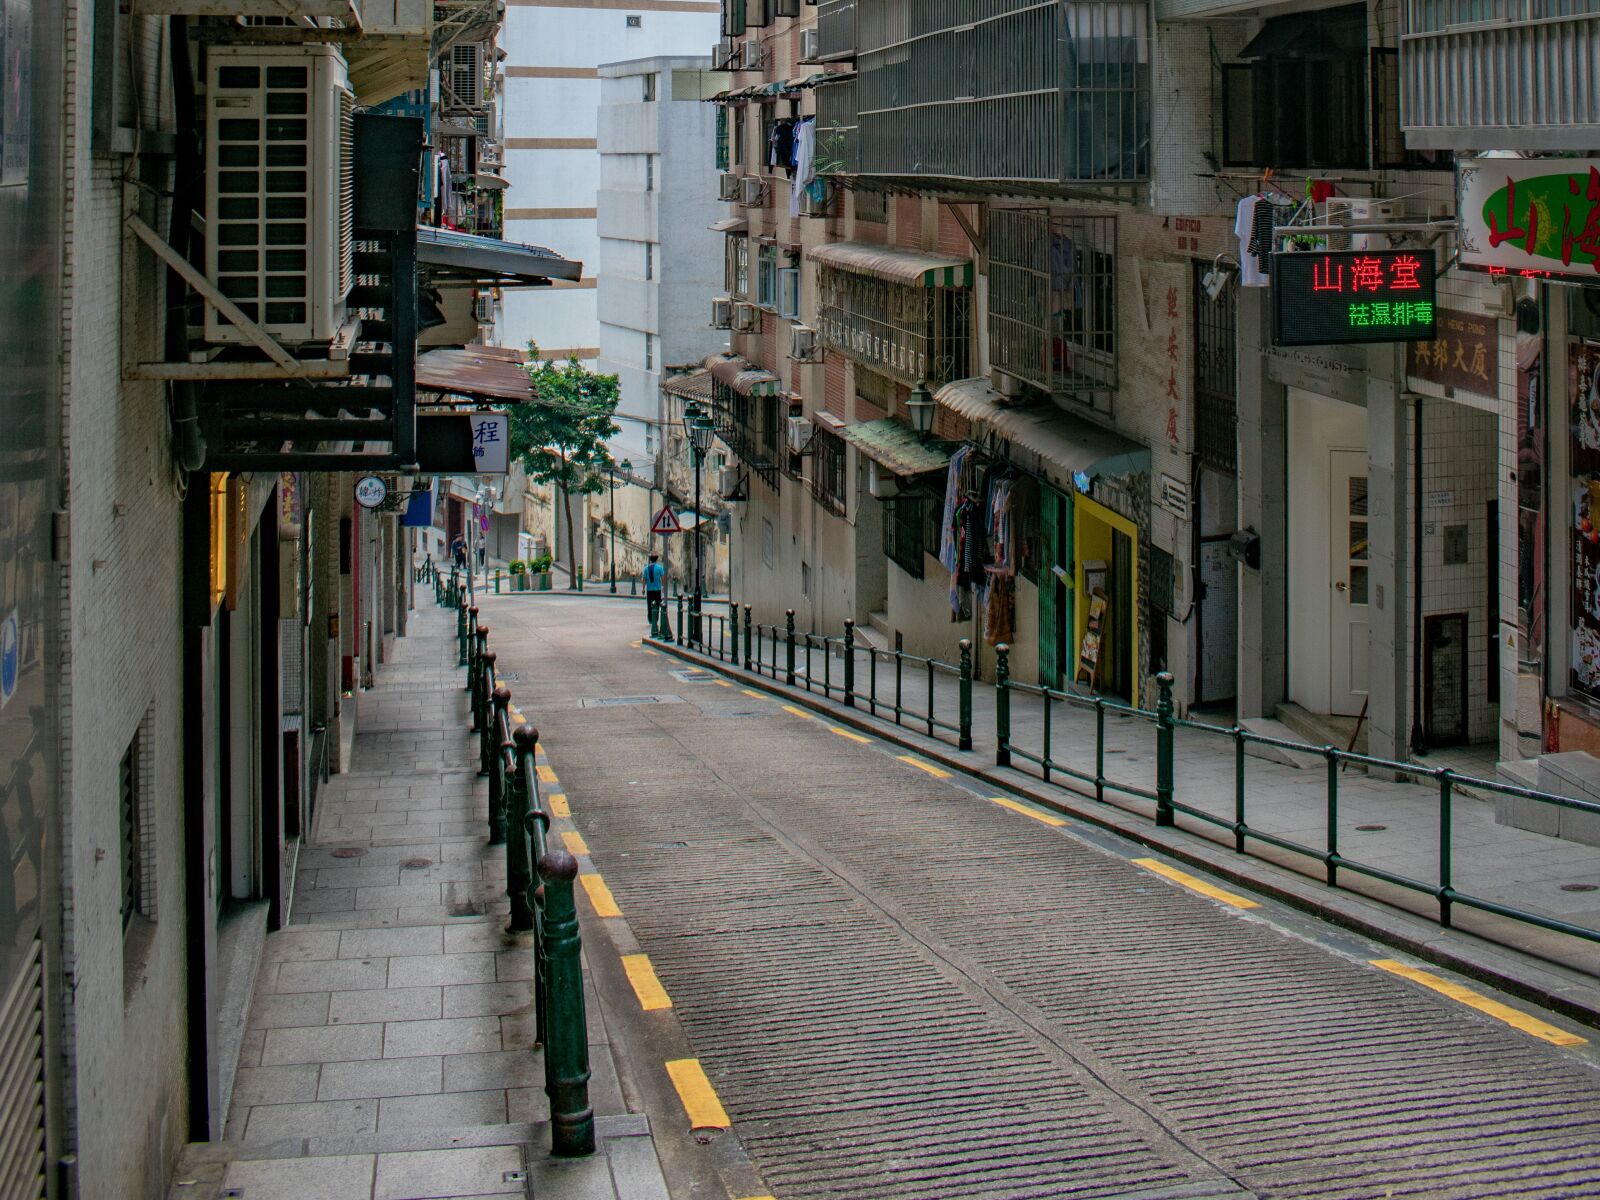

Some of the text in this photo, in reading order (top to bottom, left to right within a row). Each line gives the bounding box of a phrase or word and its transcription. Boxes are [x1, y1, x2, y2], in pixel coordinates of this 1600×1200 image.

[1313, 255, 1421, 293] 山海堂
[1349, 301, 1433, 326] 祛濕排毒
[473, 420, 501, 445] 程
